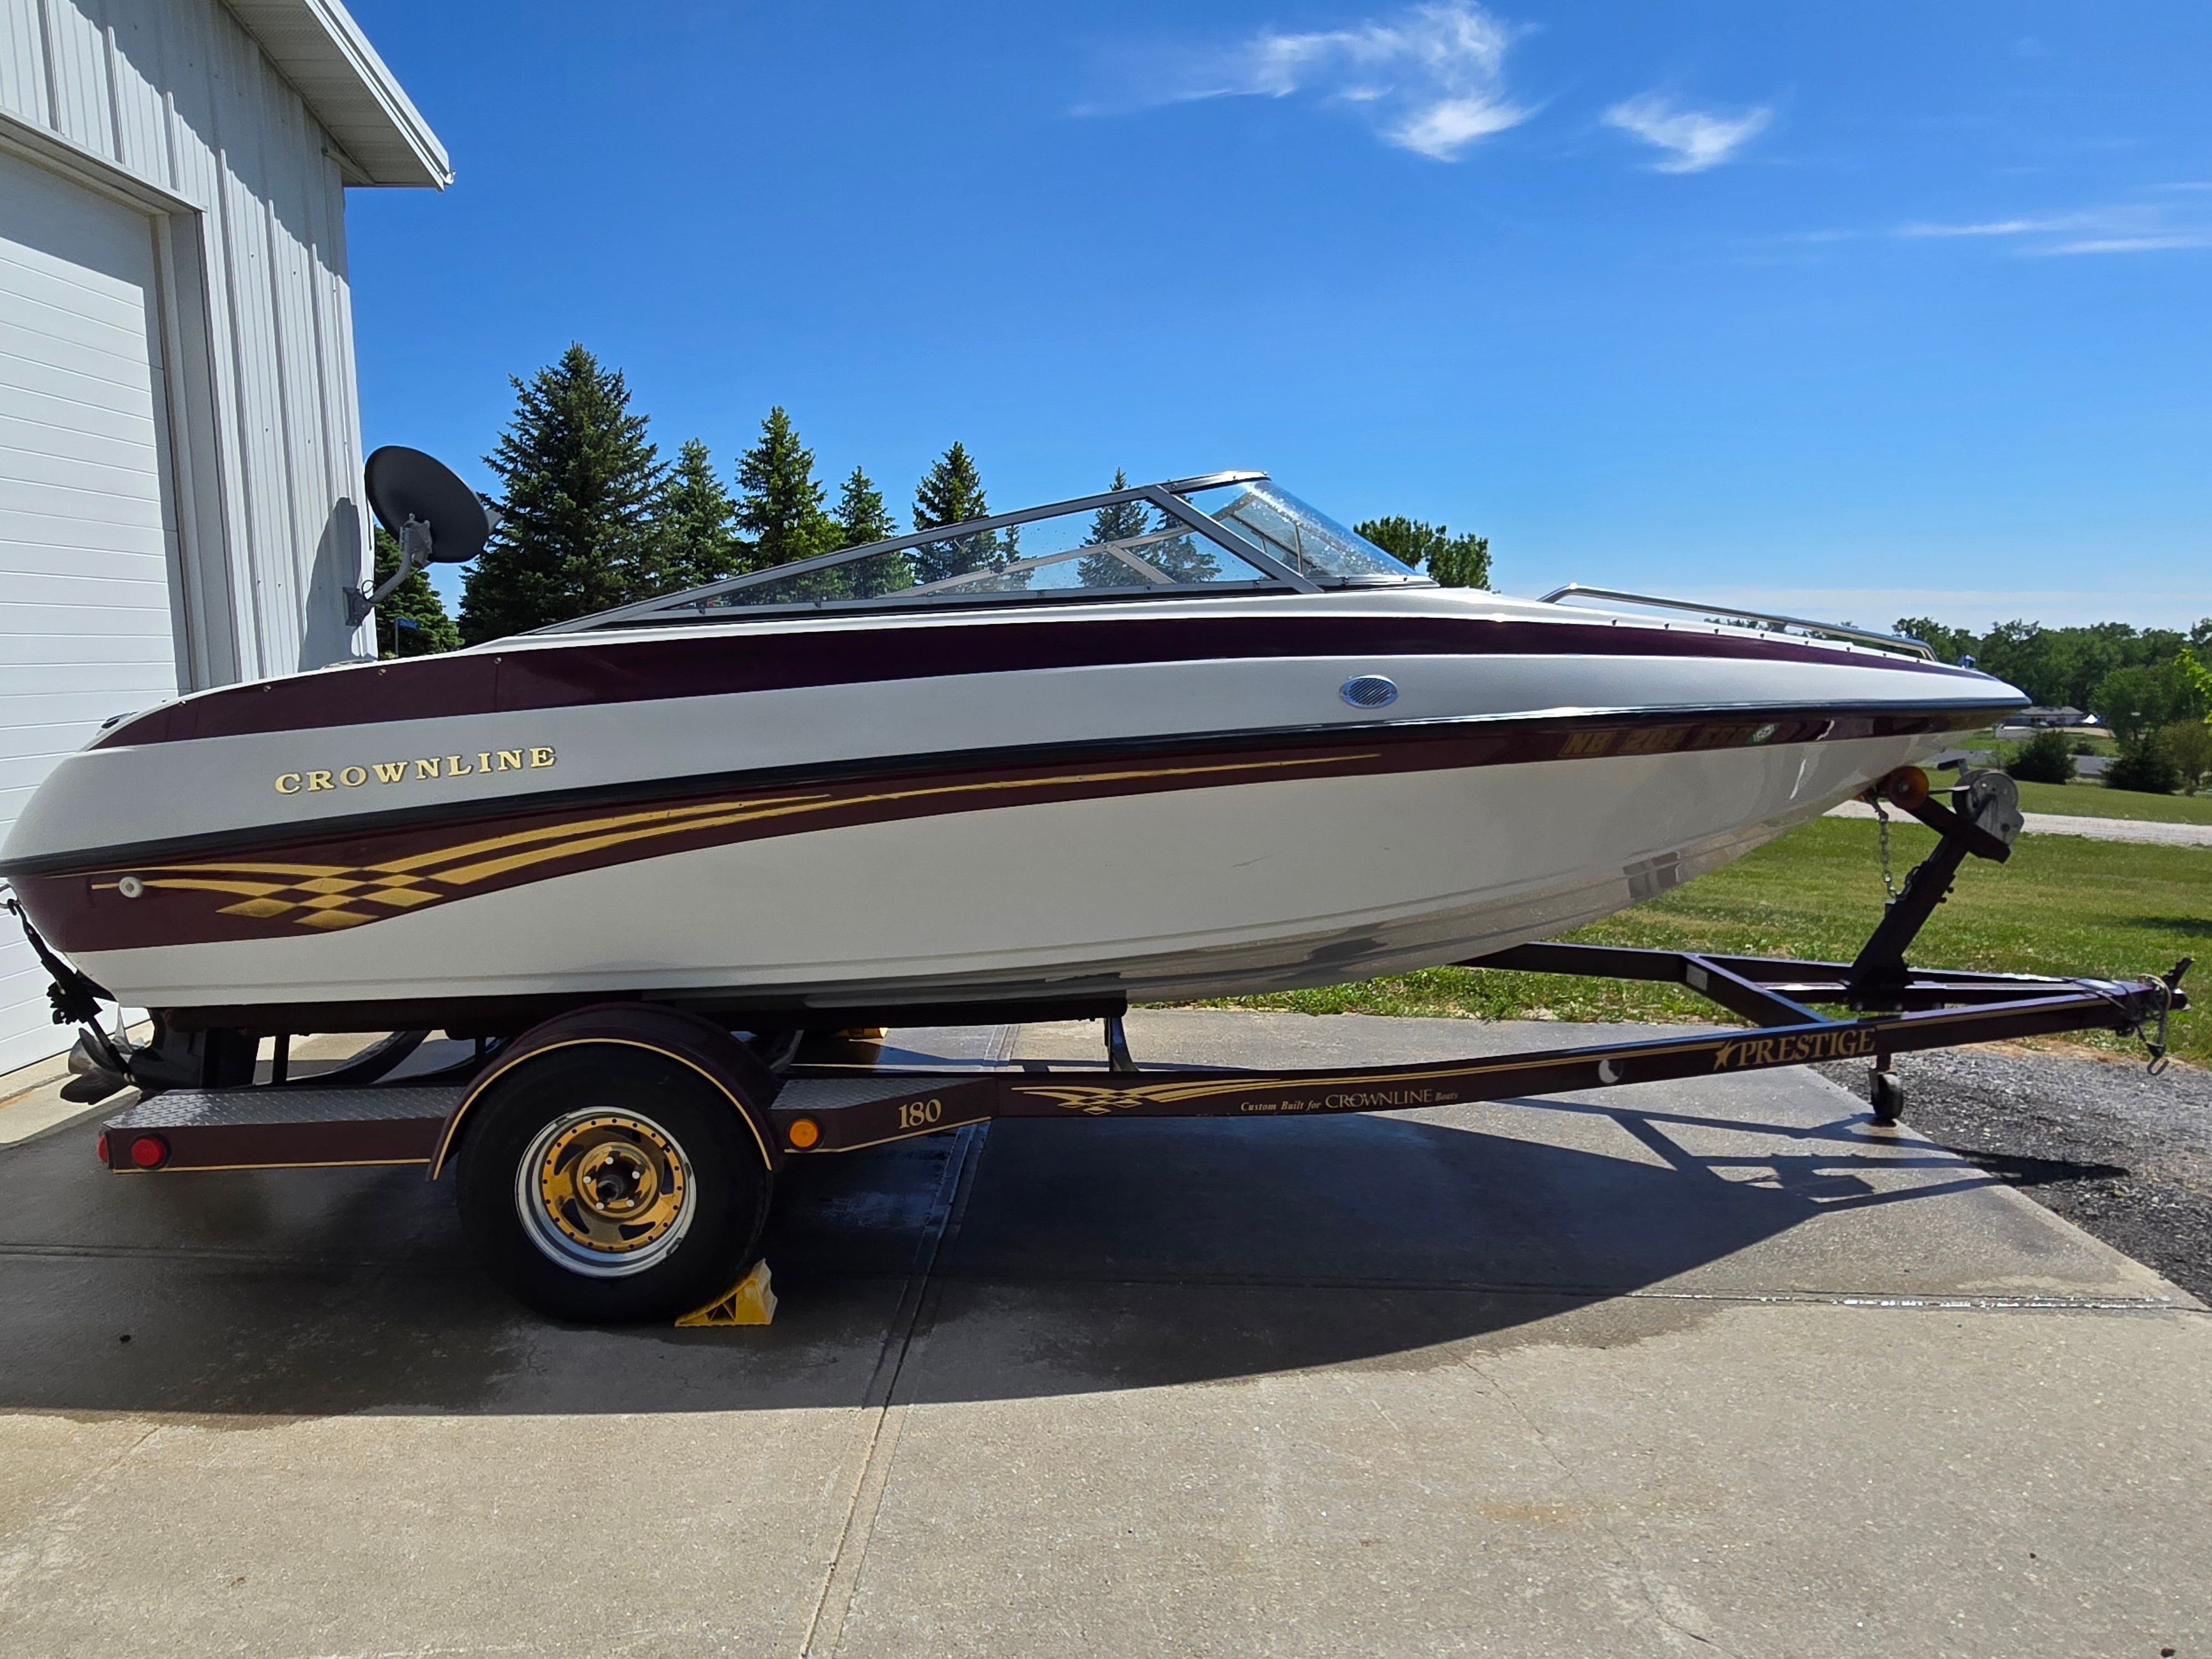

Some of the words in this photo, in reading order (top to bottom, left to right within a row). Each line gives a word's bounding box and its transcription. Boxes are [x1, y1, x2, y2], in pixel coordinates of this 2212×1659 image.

[274, 745, 557, 795] CROWNLINE
[1735, 1029, 1876, 1067] PRESTIGE
[899, 1099, 941, 1129] 180
[1240, 1102, 1276, 1111] Custom
[1281, 1100, 1305, 1110] Built
[1306, 1100, 1322, 1112] for
[1325, 1089, 1432, 1108] CROWNLINE
